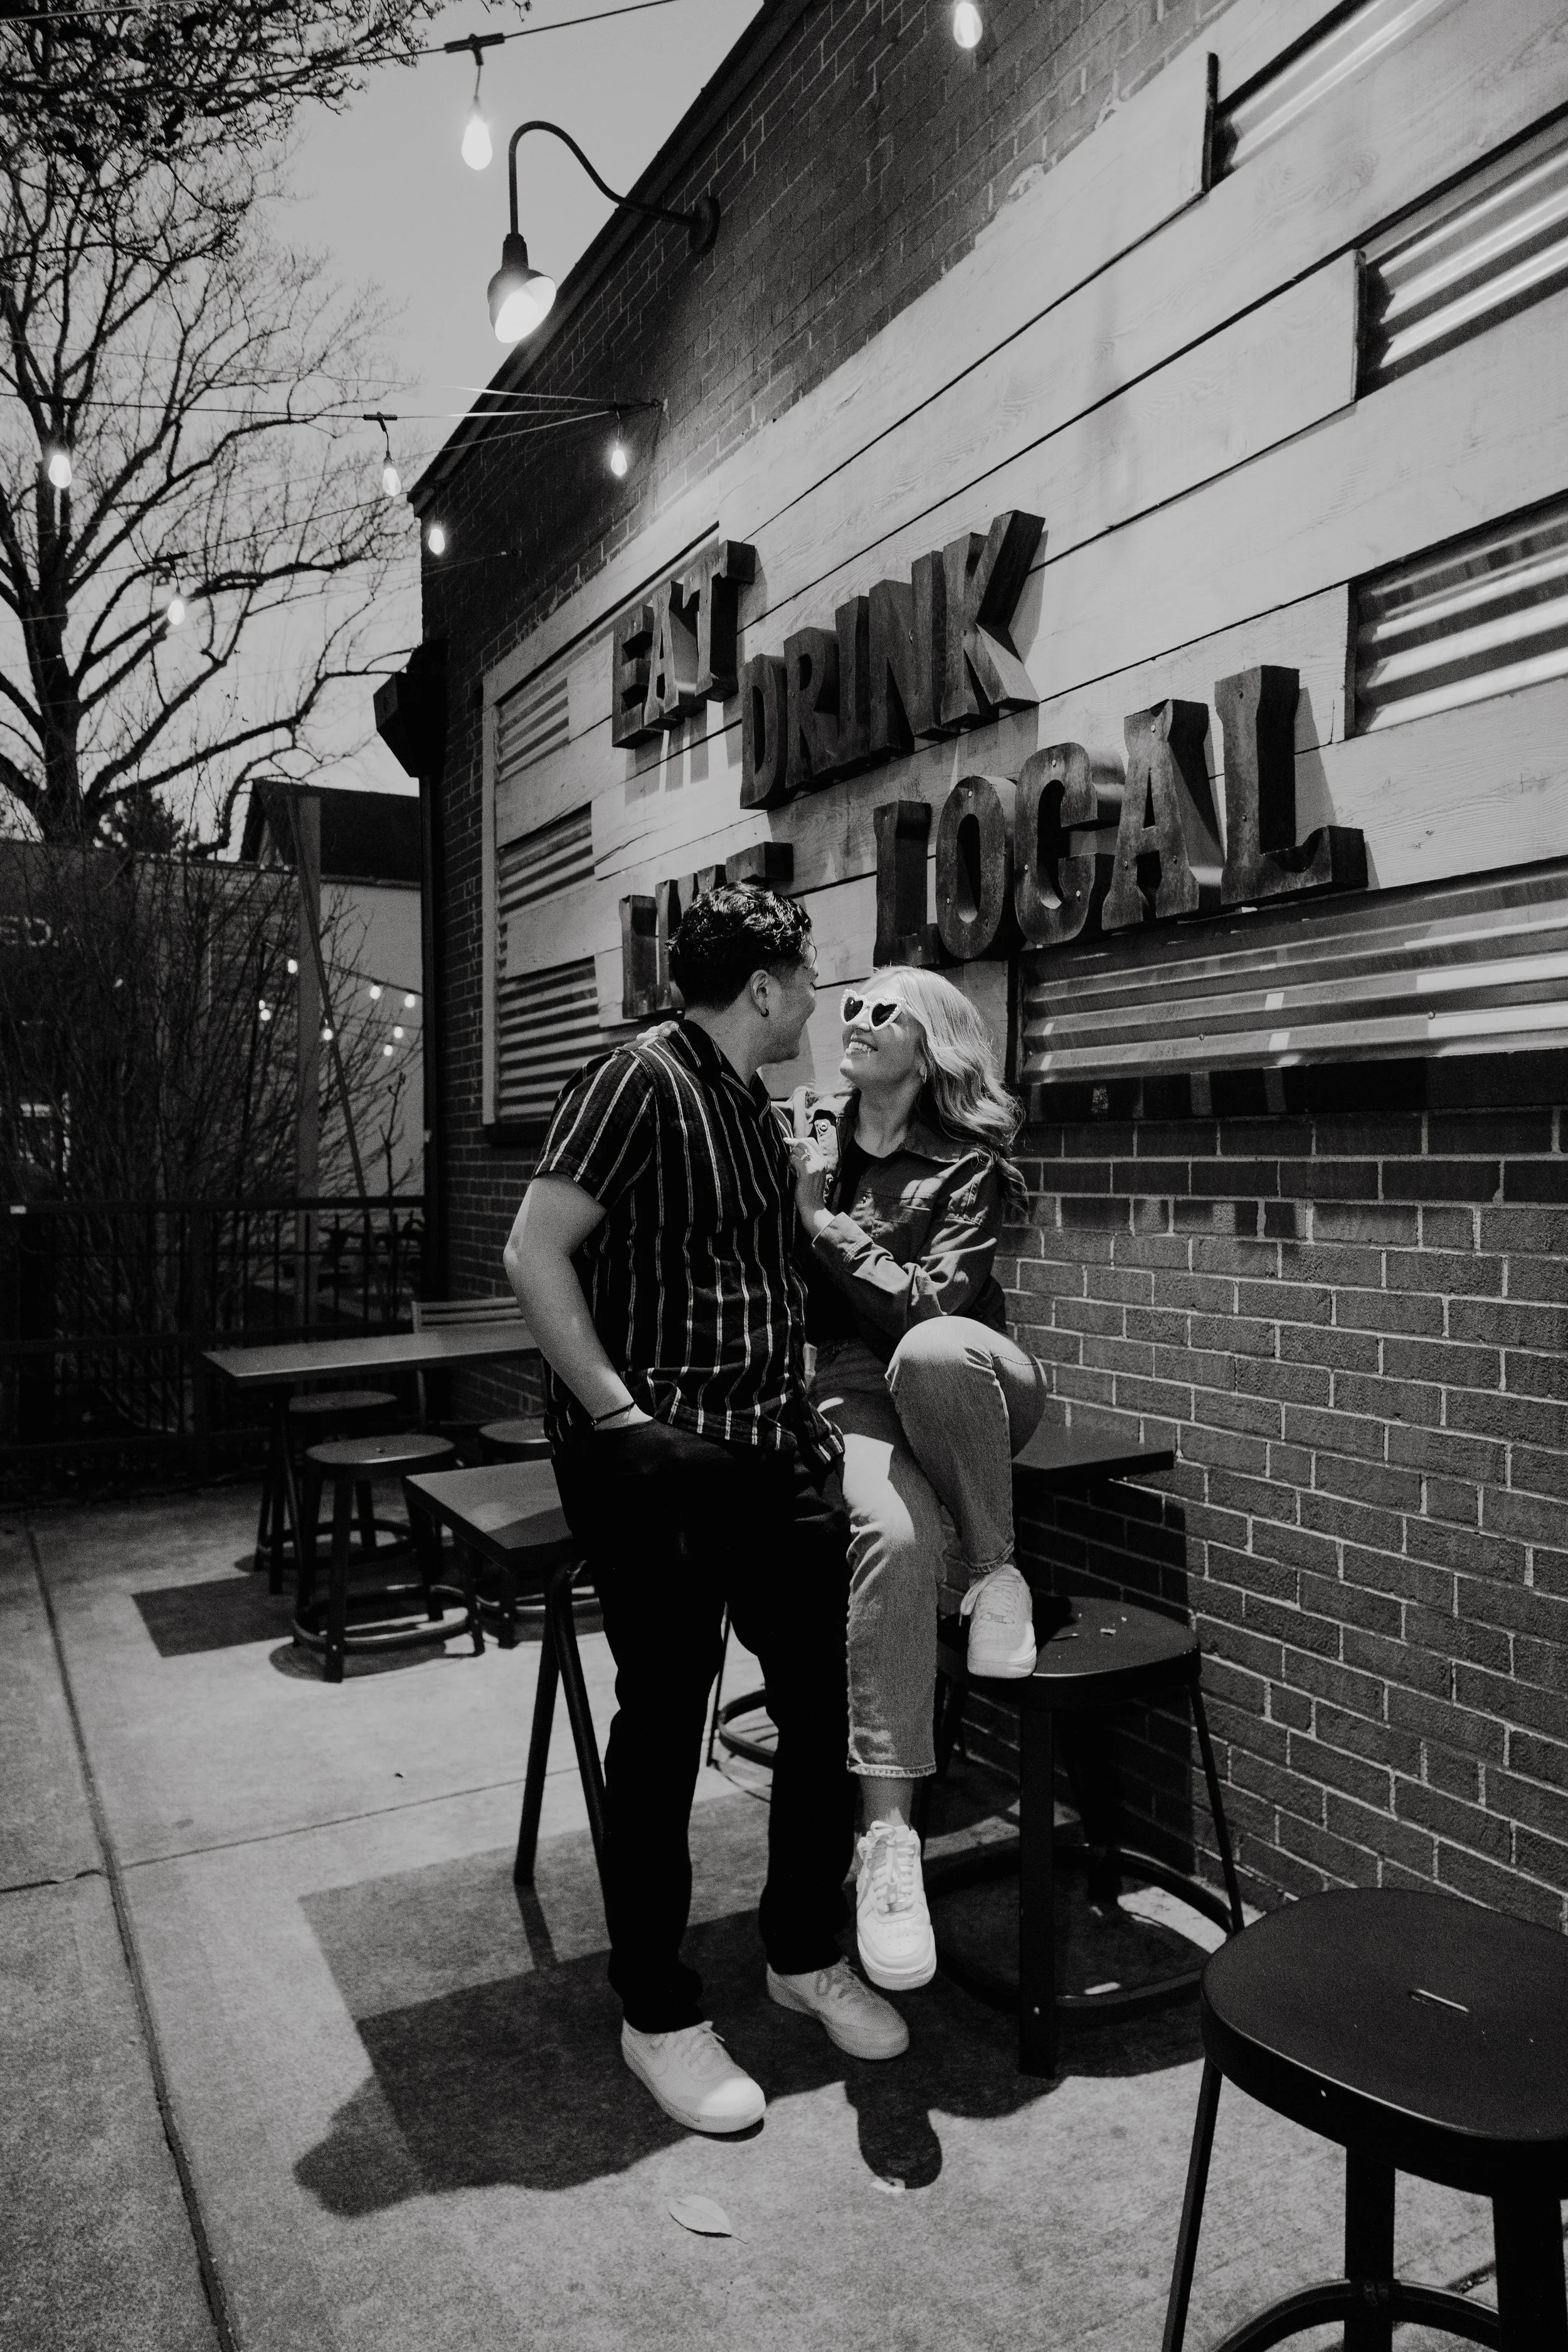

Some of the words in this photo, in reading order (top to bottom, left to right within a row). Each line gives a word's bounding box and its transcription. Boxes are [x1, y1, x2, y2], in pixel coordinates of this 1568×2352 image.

[612, 540, 755, 748] EAT
[740, 510, 1046, 810] DRINK
[619, 841, 793, 1019] LI
[874, 665, 1369, 967] LOCAL
